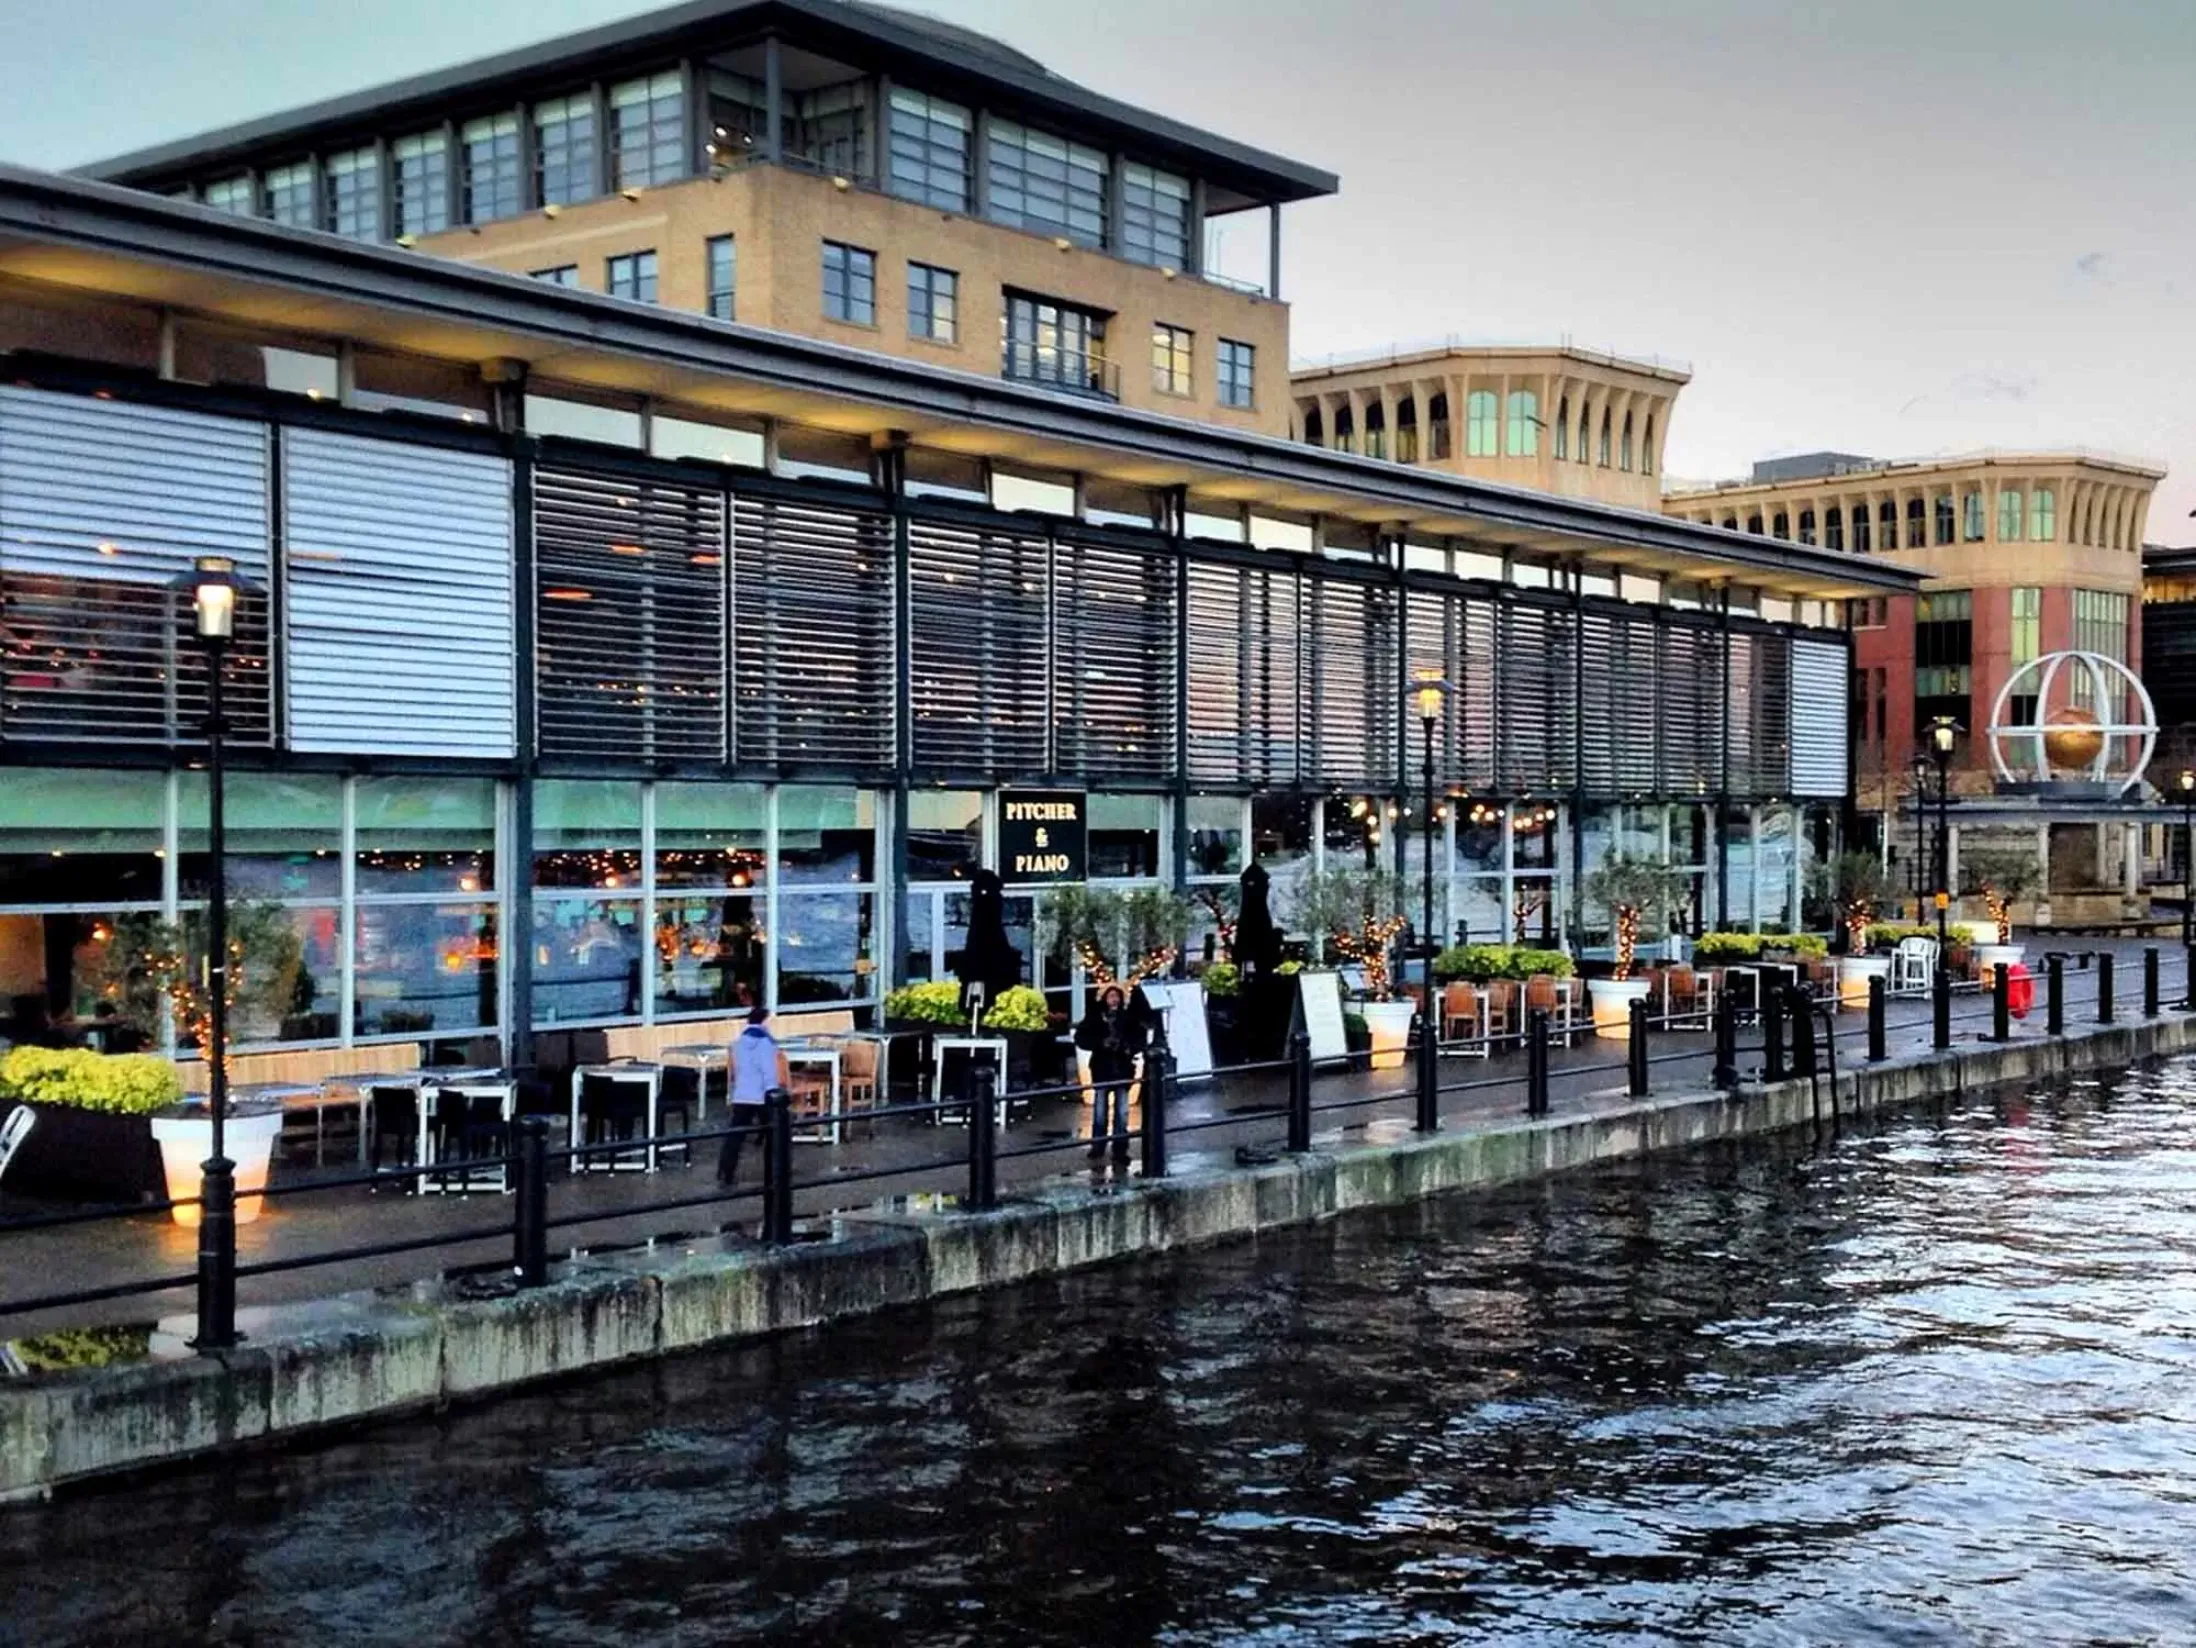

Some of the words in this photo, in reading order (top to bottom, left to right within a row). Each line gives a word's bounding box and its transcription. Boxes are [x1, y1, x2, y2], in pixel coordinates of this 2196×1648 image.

[1006, 803, 1077, 820] PITCHER
[1035, 827, 1049, 848] &
[1015, 854, 1070, 873] PIANO
